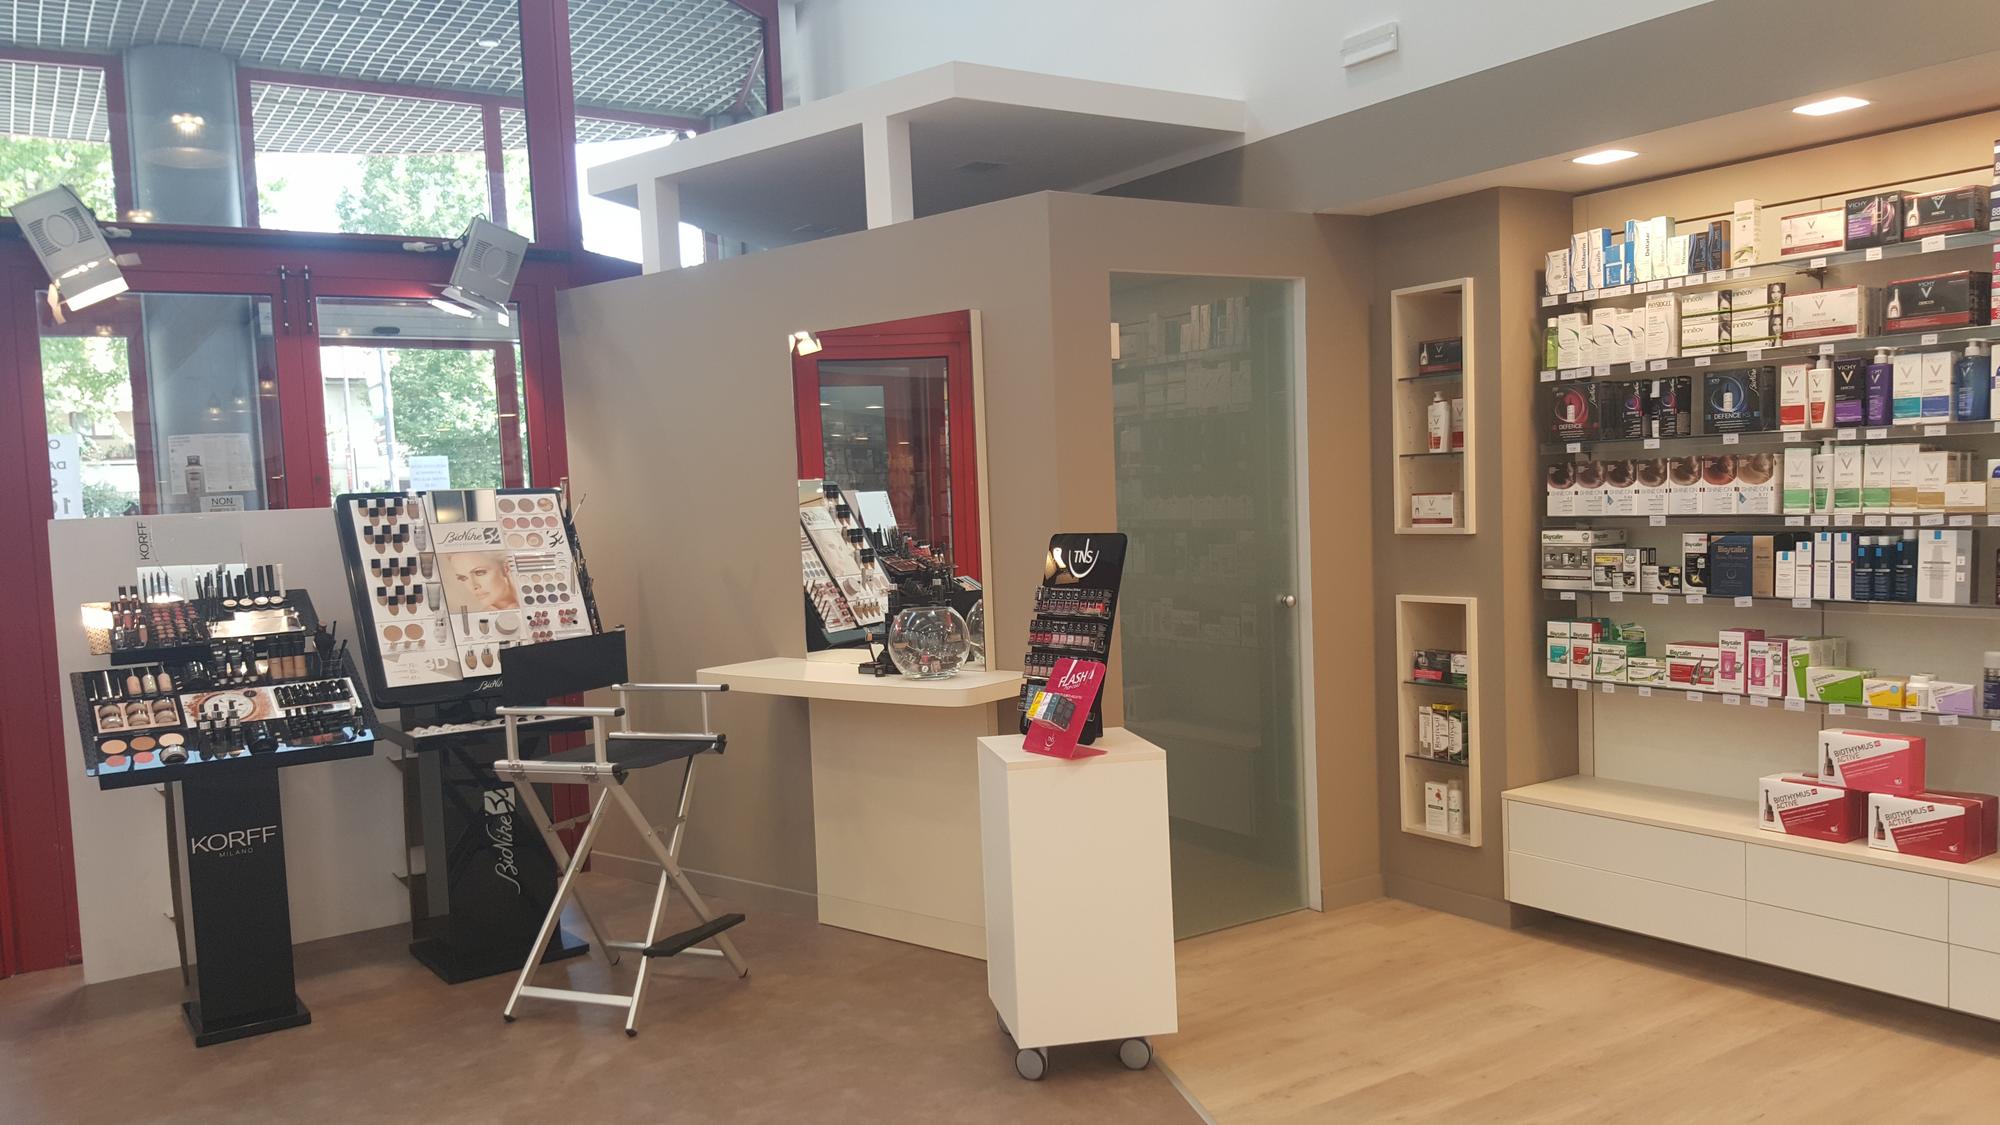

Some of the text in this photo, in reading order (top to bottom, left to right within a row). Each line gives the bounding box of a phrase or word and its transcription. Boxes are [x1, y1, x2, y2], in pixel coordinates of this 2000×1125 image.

[1848, 201, 1867, 209] VICHY
[1558, 422, 1583, 430] DEFENCE
[211, 497, 233, 505] NON
[136, 521, 150, 561] KORFF
[1074, 541, 1094, 563] TNS
[1833, 741, 1874, 758] BIOTHYMUS
[1837, 752, 1861, 763] ACTIVE
[1773, 789, 1811, 805] BIOTHYMUS
[1776, 799, 1799, 811] ACTIVE
[1884, 806, 1927, 821] BIOTHYMUS
[1888, 816, 1913, 828] ACTIVE
[191, 825, 277, 855] KORFF
[219, 847, 254, 857] MILANO
[485, 814, 521, 895] BioNike
